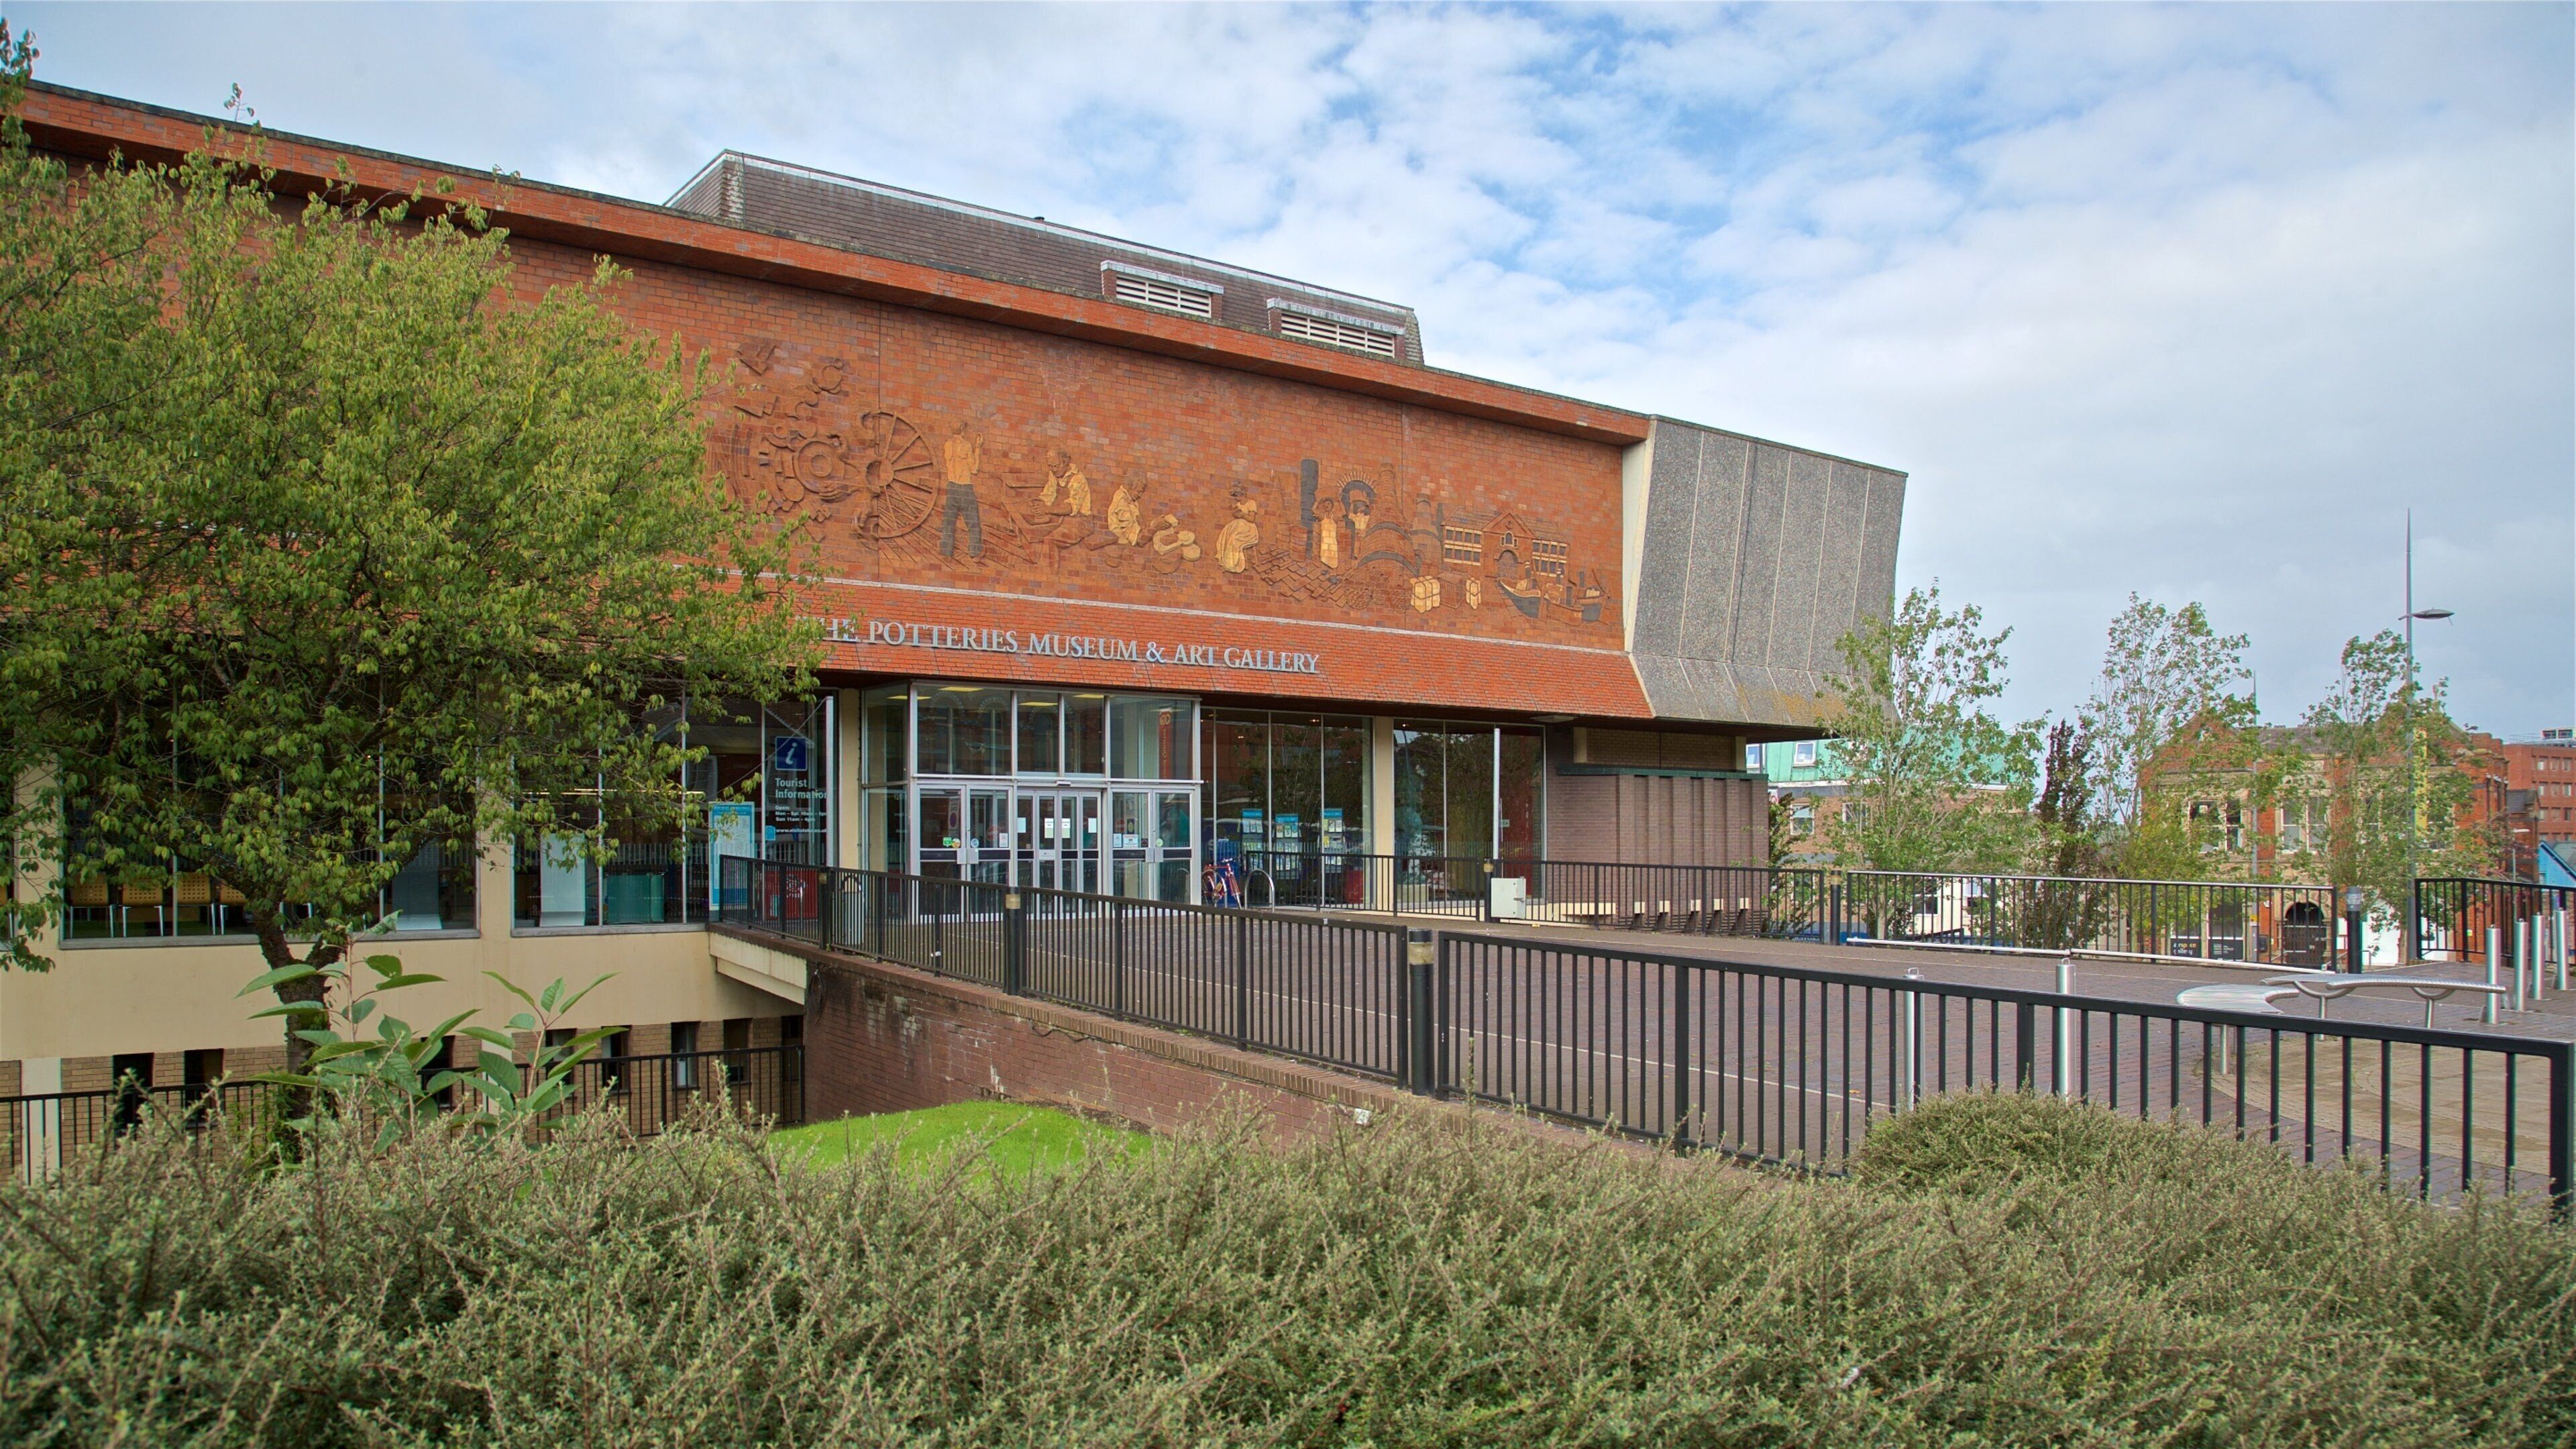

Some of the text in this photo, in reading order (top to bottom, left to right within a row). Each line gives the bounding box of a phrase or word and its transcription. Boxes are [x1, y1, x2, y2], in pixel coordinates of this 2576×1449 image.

[868, 621, 1018, 653] POTTERIES
[1028, 633, 1138, 661] MUSEUM
[1146, 641, 1167, 663] &
[1174, 644, 1218, 666] ART
[1224, 647, 1320, 674] GALLERY
[775, 778, 808, 787] Tourist
